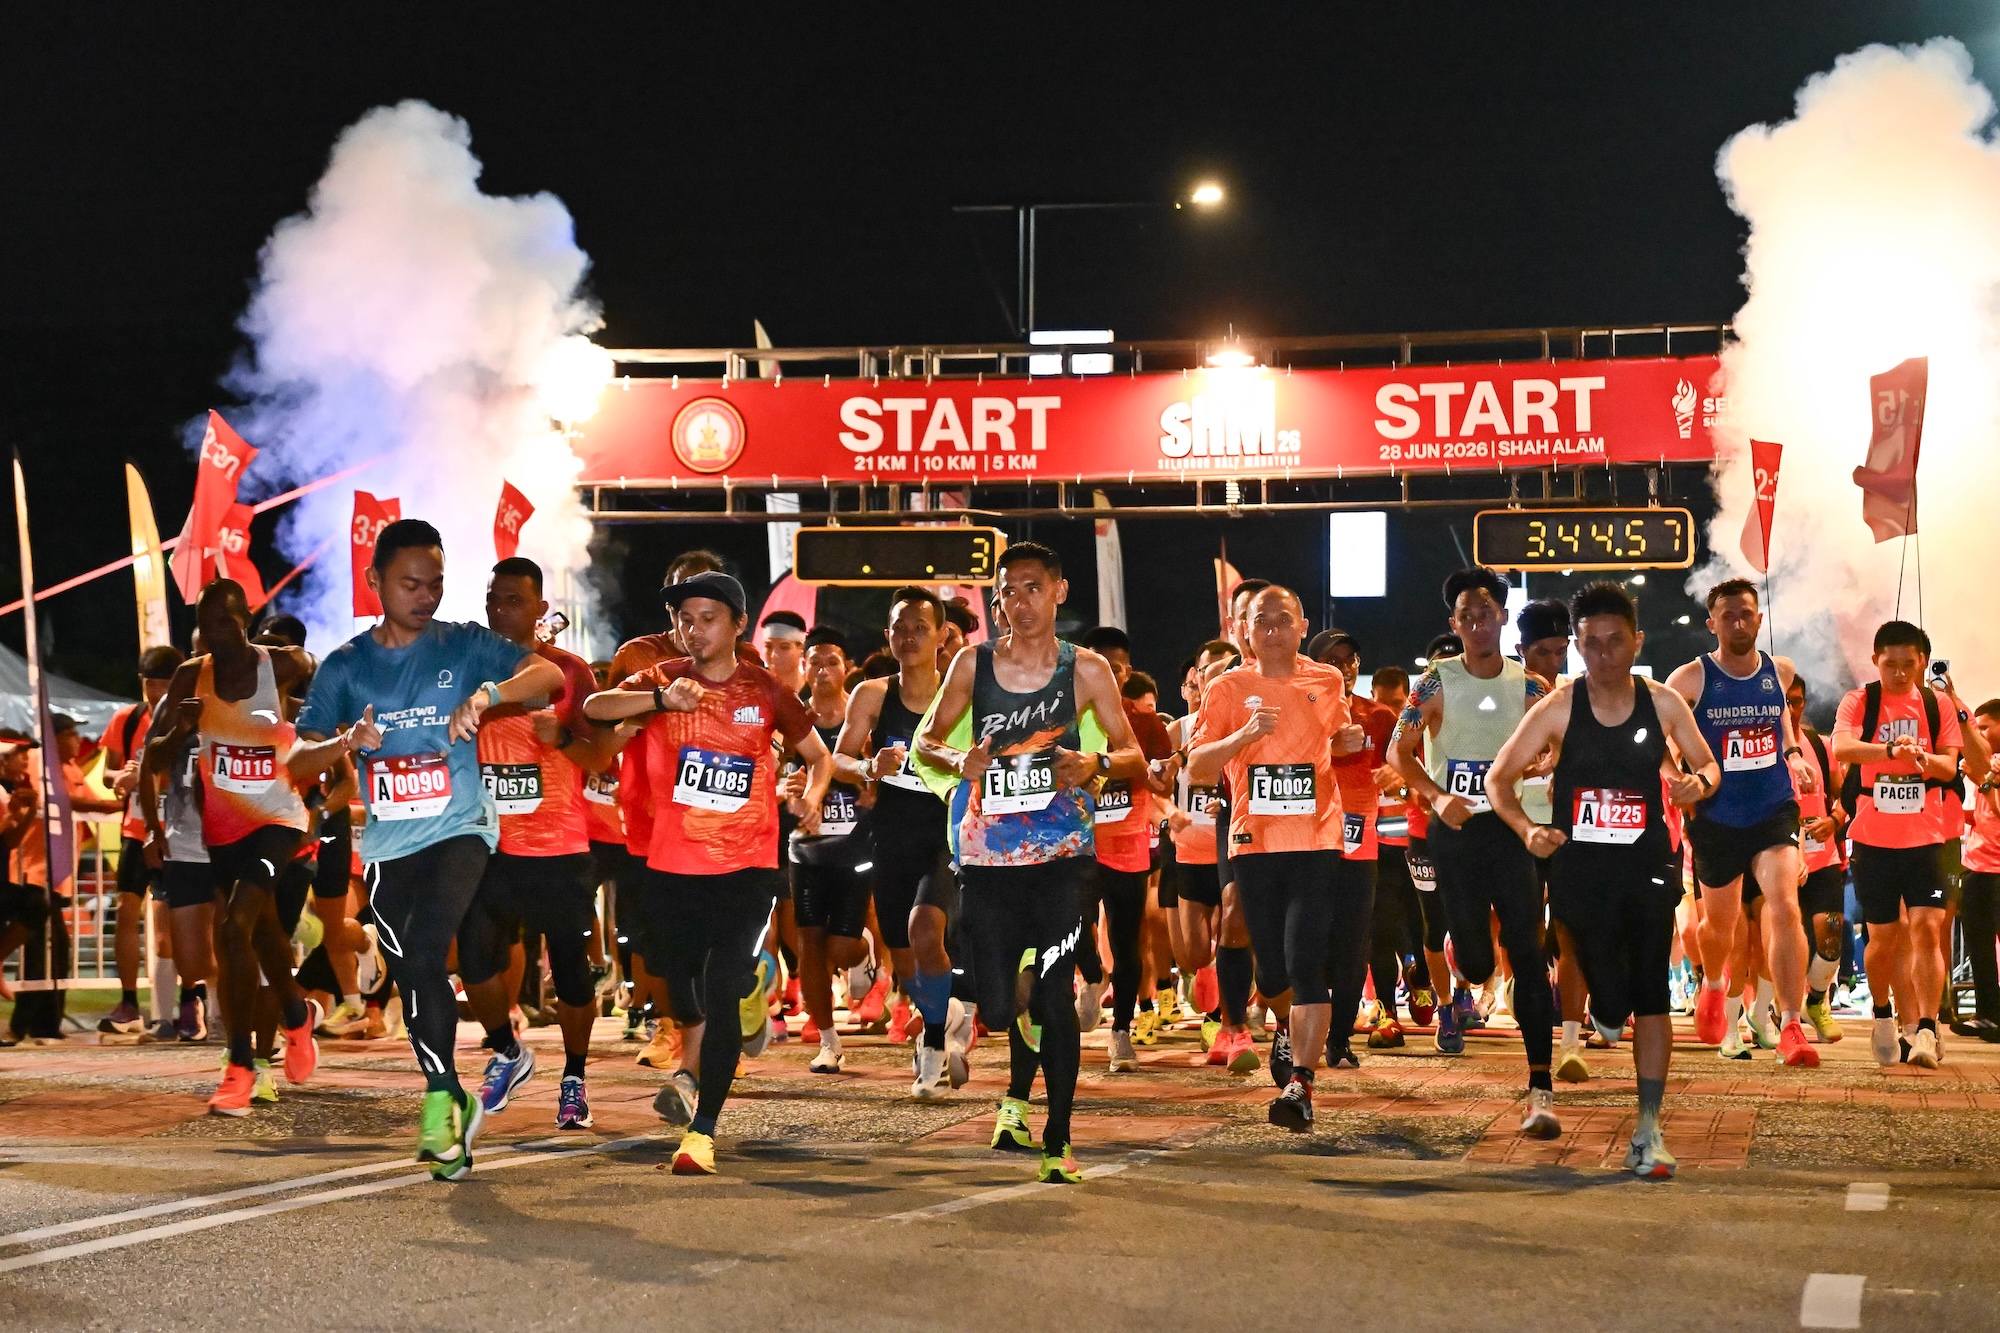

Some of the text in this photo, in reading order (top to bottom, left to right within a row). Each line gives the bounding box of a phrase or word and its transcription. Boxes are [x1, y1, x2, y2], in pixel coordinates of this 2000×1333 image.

[1374, 376, 1606, 441] START
[838, 396, 1062, 453] START
[1277, 429, 1301, 454] 26
[1379, 444, 1402, 460] 28
[1404, 443, 1440, 459] JUN
[1443, 441, 1488, 458] 2026
[1498, 439, 1549, 456] SHAH
[1552, 437, 1604, 454] ALAM
[854, 455, 874, 470] 21
[878, 455, 906, 470] KM
[923, 455, 944, 470] 10
[949, 455, 976, 470] KM
[992, 455, 1004, 470] 5
[1008, 454, 1037, 470] KM
[422, 716, 450, 727] CLU
[733, 705, 760, 724] SHM
[1706, 705, 1781, 719] SUNDERLAND
[1878, 719, 1928, 745] SHM 26
[1730, 741, 1741, 758] A
[1745, 733, 1774, 754] 0135
[218, 757, 272, 776] A 0116
[378, 769, 446, 801] A 0090
[498, 776, 538, 796] 0579
[684, 764, 749, 793] C 1085
[990, 767, 1052, 796] E 0589
[1257, 777, 1312, 799] E 0002
[1455, 773, 1467, 793] C
[1880, 786, 1919, 800] PACER
[823, 803, 855, 820] 0515
[1195, 796, 1203, 812] E
[1581, 803, 1642, 825] A 0225
[1411, 864, 1436, 878] 0499
